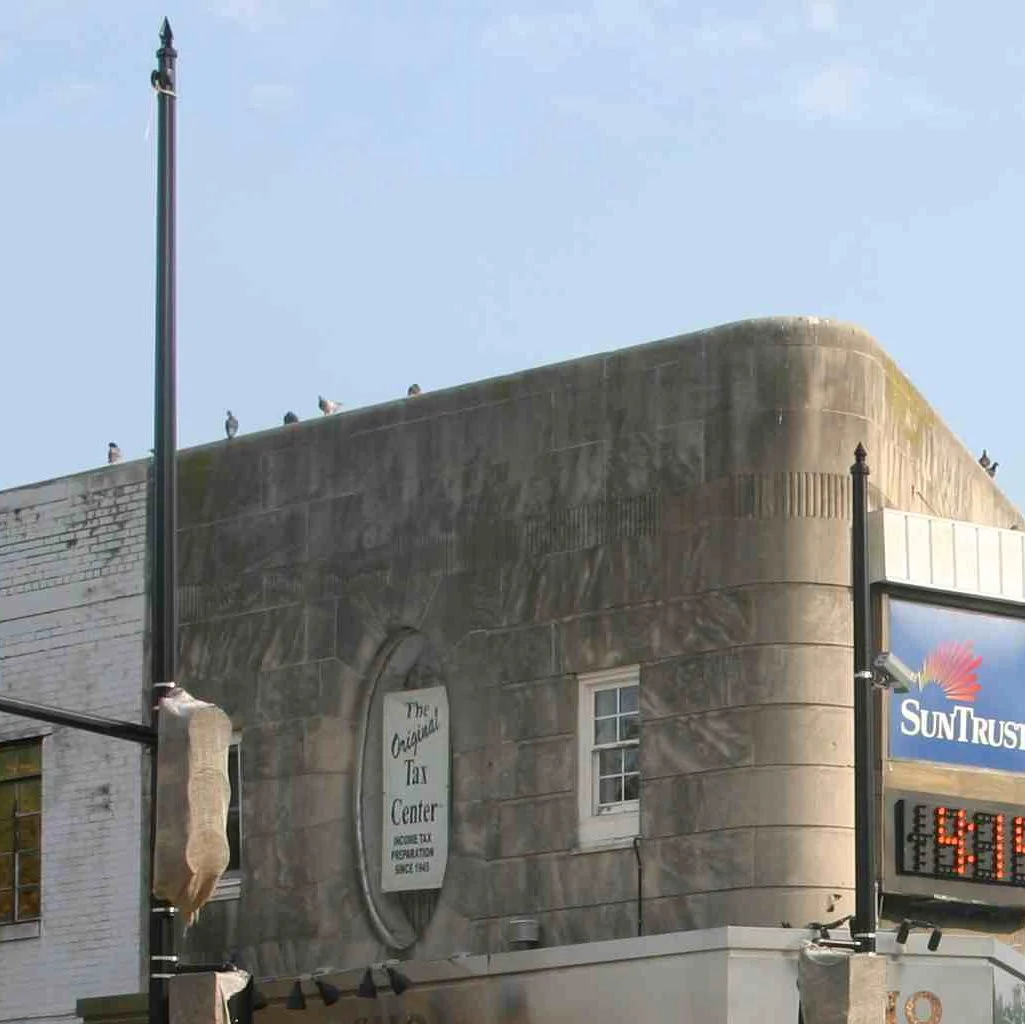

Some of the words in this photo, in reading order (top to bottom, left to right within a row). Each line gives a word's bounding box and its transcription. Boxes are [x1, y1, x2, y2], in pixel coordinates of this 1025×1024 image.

[404, 702, 430, 718] The
[391, 707, 439, 759] Original
[404, 759, 427, 786] Tax
[391, 798, 438, 826] Center
[419, 833, 432, 844] TAX
